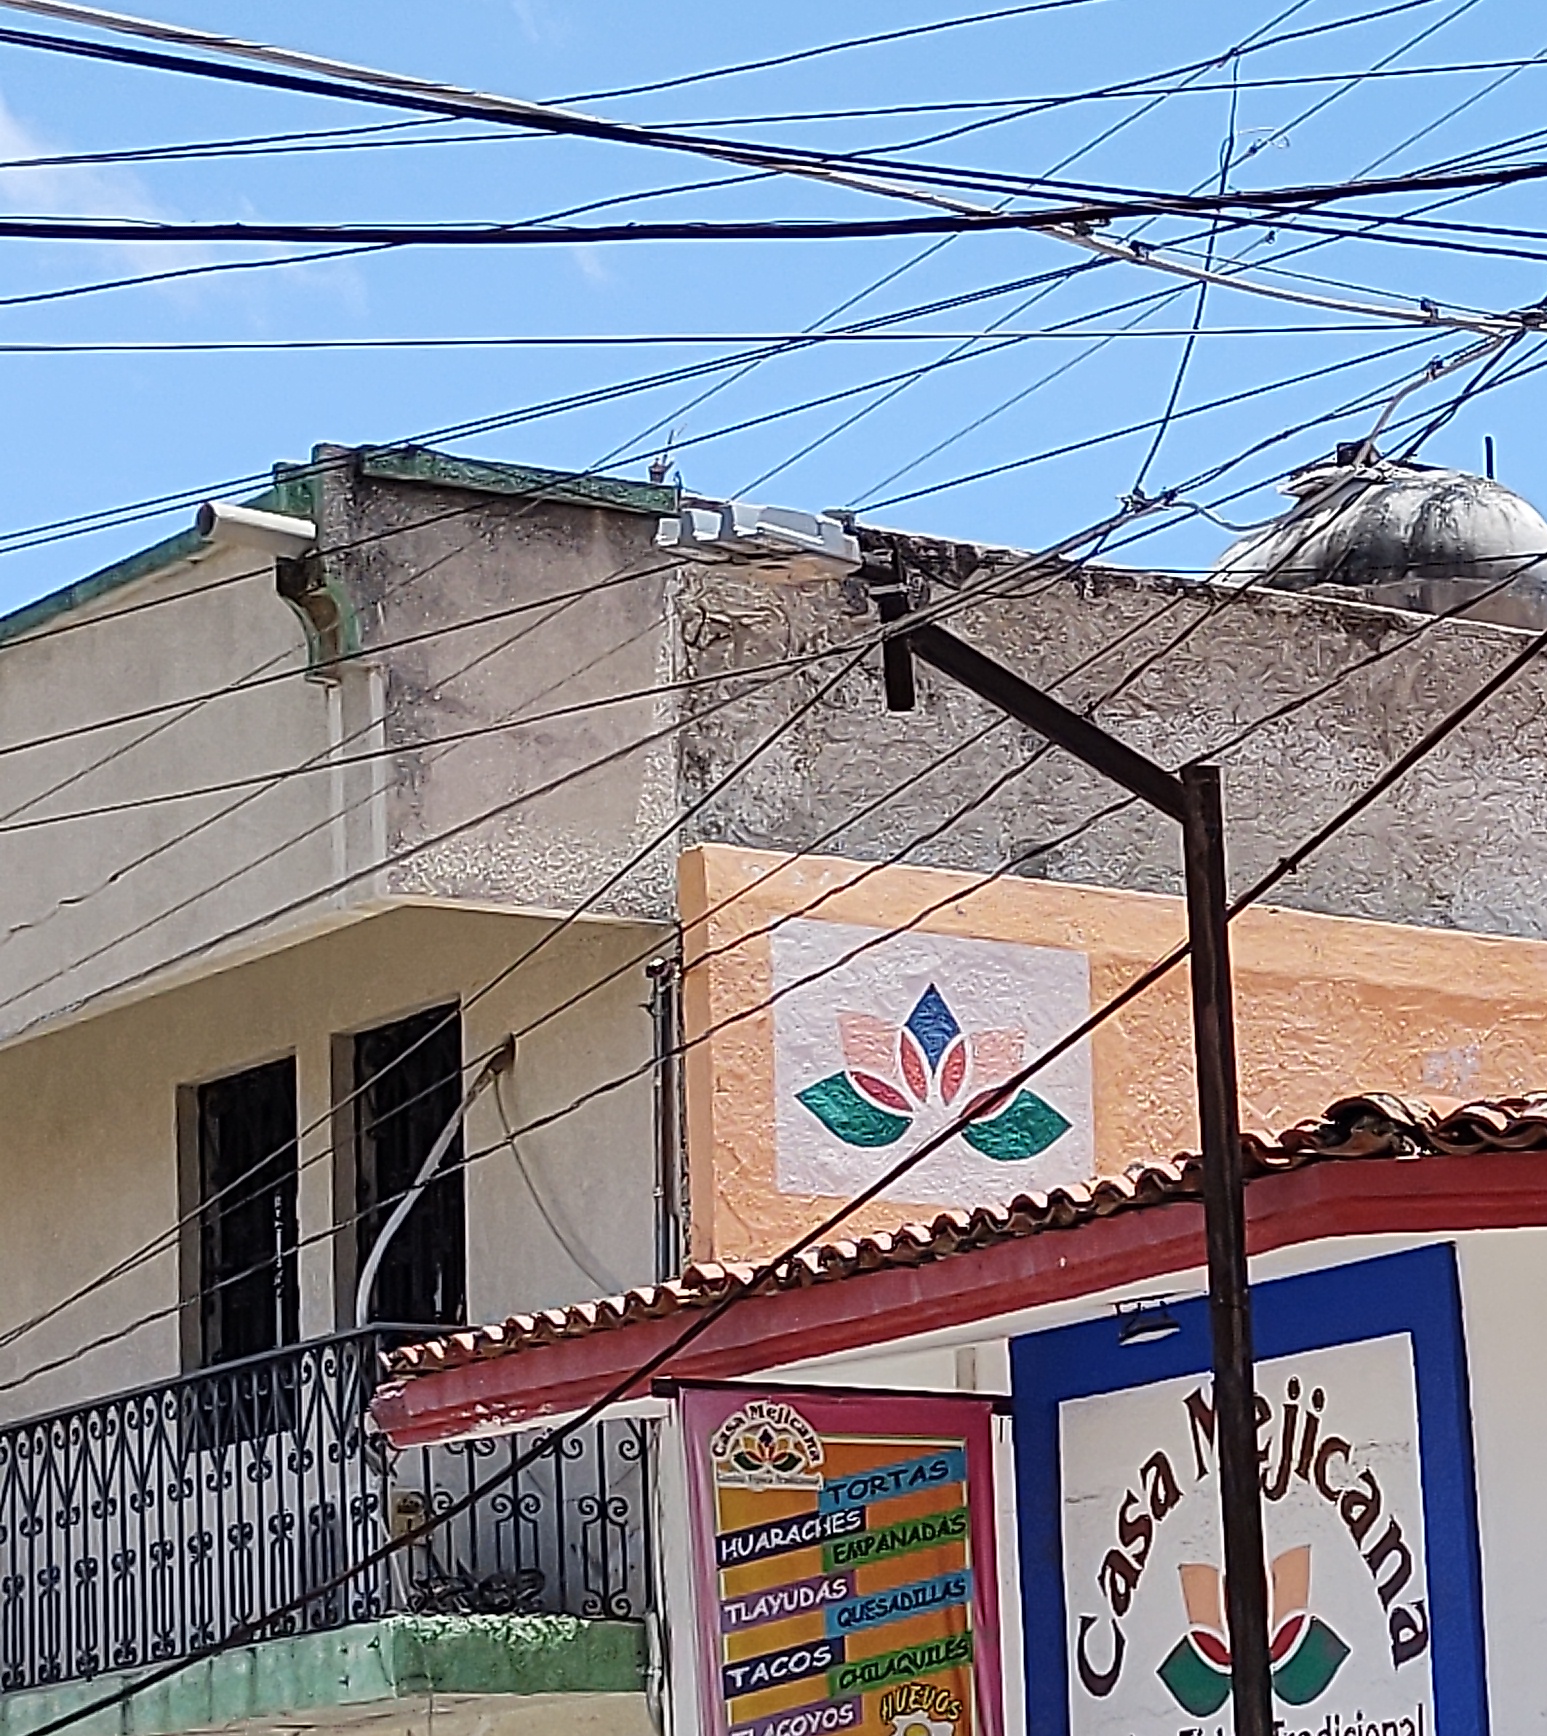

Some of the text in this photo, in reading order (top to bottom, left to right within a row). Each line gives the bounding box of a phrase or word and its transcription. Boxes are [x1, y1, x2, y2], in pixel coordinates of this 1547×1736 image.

[826, 1459, 949, 1505] TORTAS
[721, 1509, 861, 1562] HUARACHES
[832, 1514, 966, 1565] EMPANADAS
[1076, 1450, 1184, 1698] Casa
[724, 1578, 848, 1626] TLAYUDAS
[837, 1578, 966, 1627] QUESADILLAS
[726, 1645, 832, 1690] TACOS
[839, 1639, 969, 1690] CHILAQUILES
